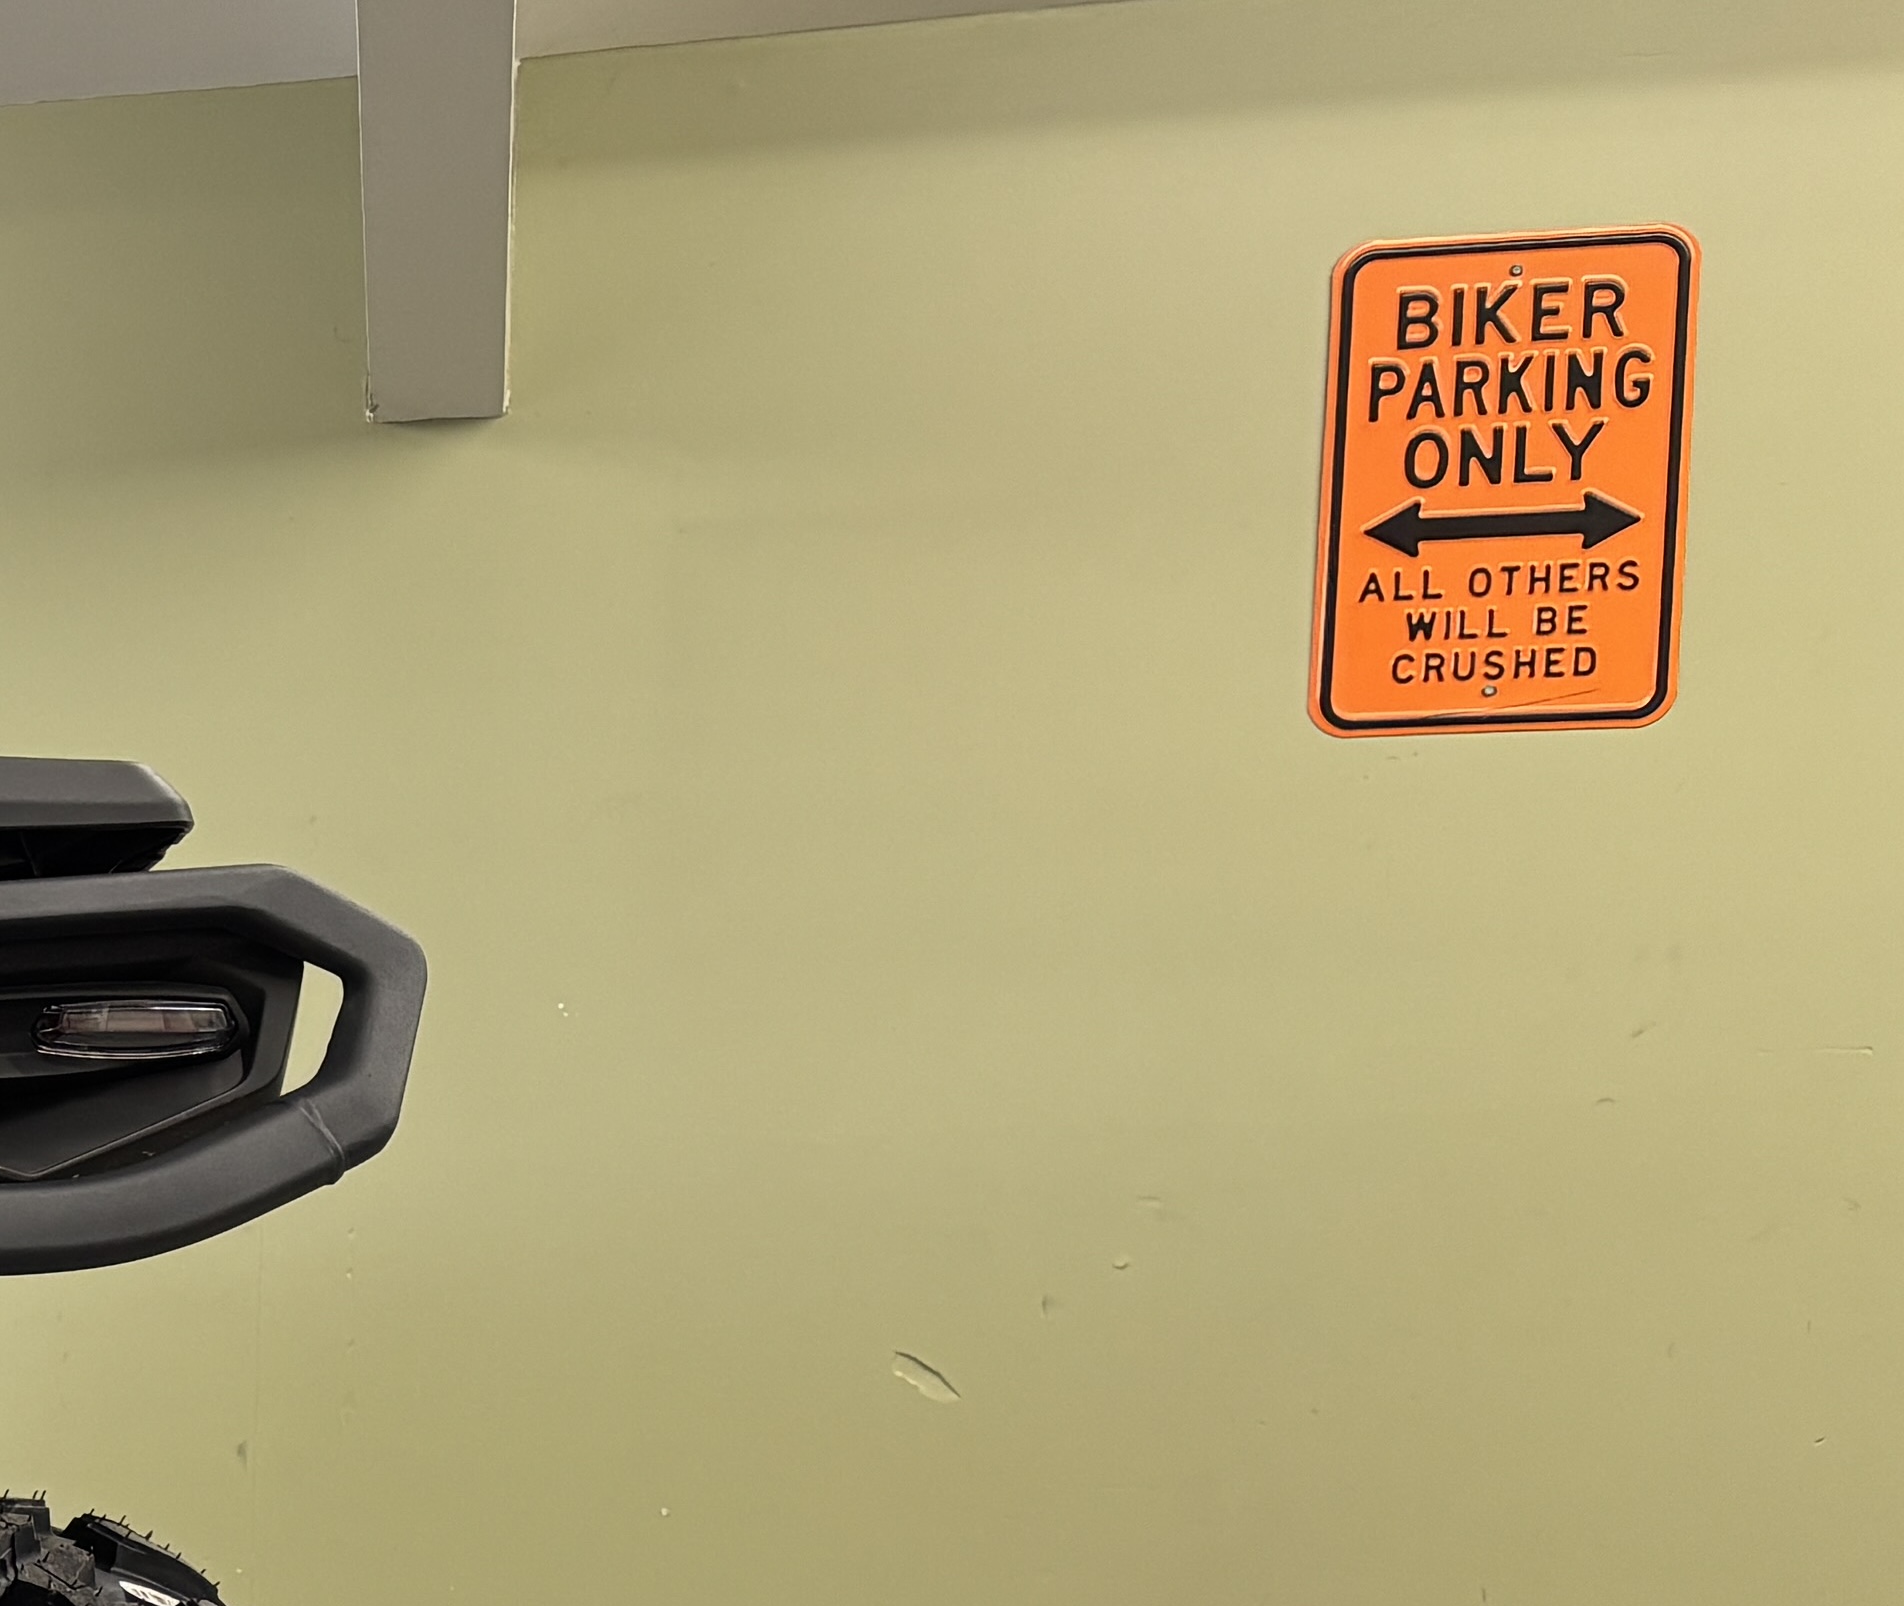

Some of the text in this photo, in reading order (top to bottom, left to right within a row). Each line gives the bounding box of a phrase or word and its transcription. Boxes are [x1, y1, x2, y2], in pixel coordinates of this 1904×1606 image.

[1397, 279, 1626, 350] BIKER
[1368, 349, 1652, 422] PARKING
[1404, 420, 1605, 488] ONLY
[1358, 560, 1640, 603] ALL OTHERS
[1406, 605, 1588, 642] WILL BE
[1392, 647, 1597, 685] CRUSHED
